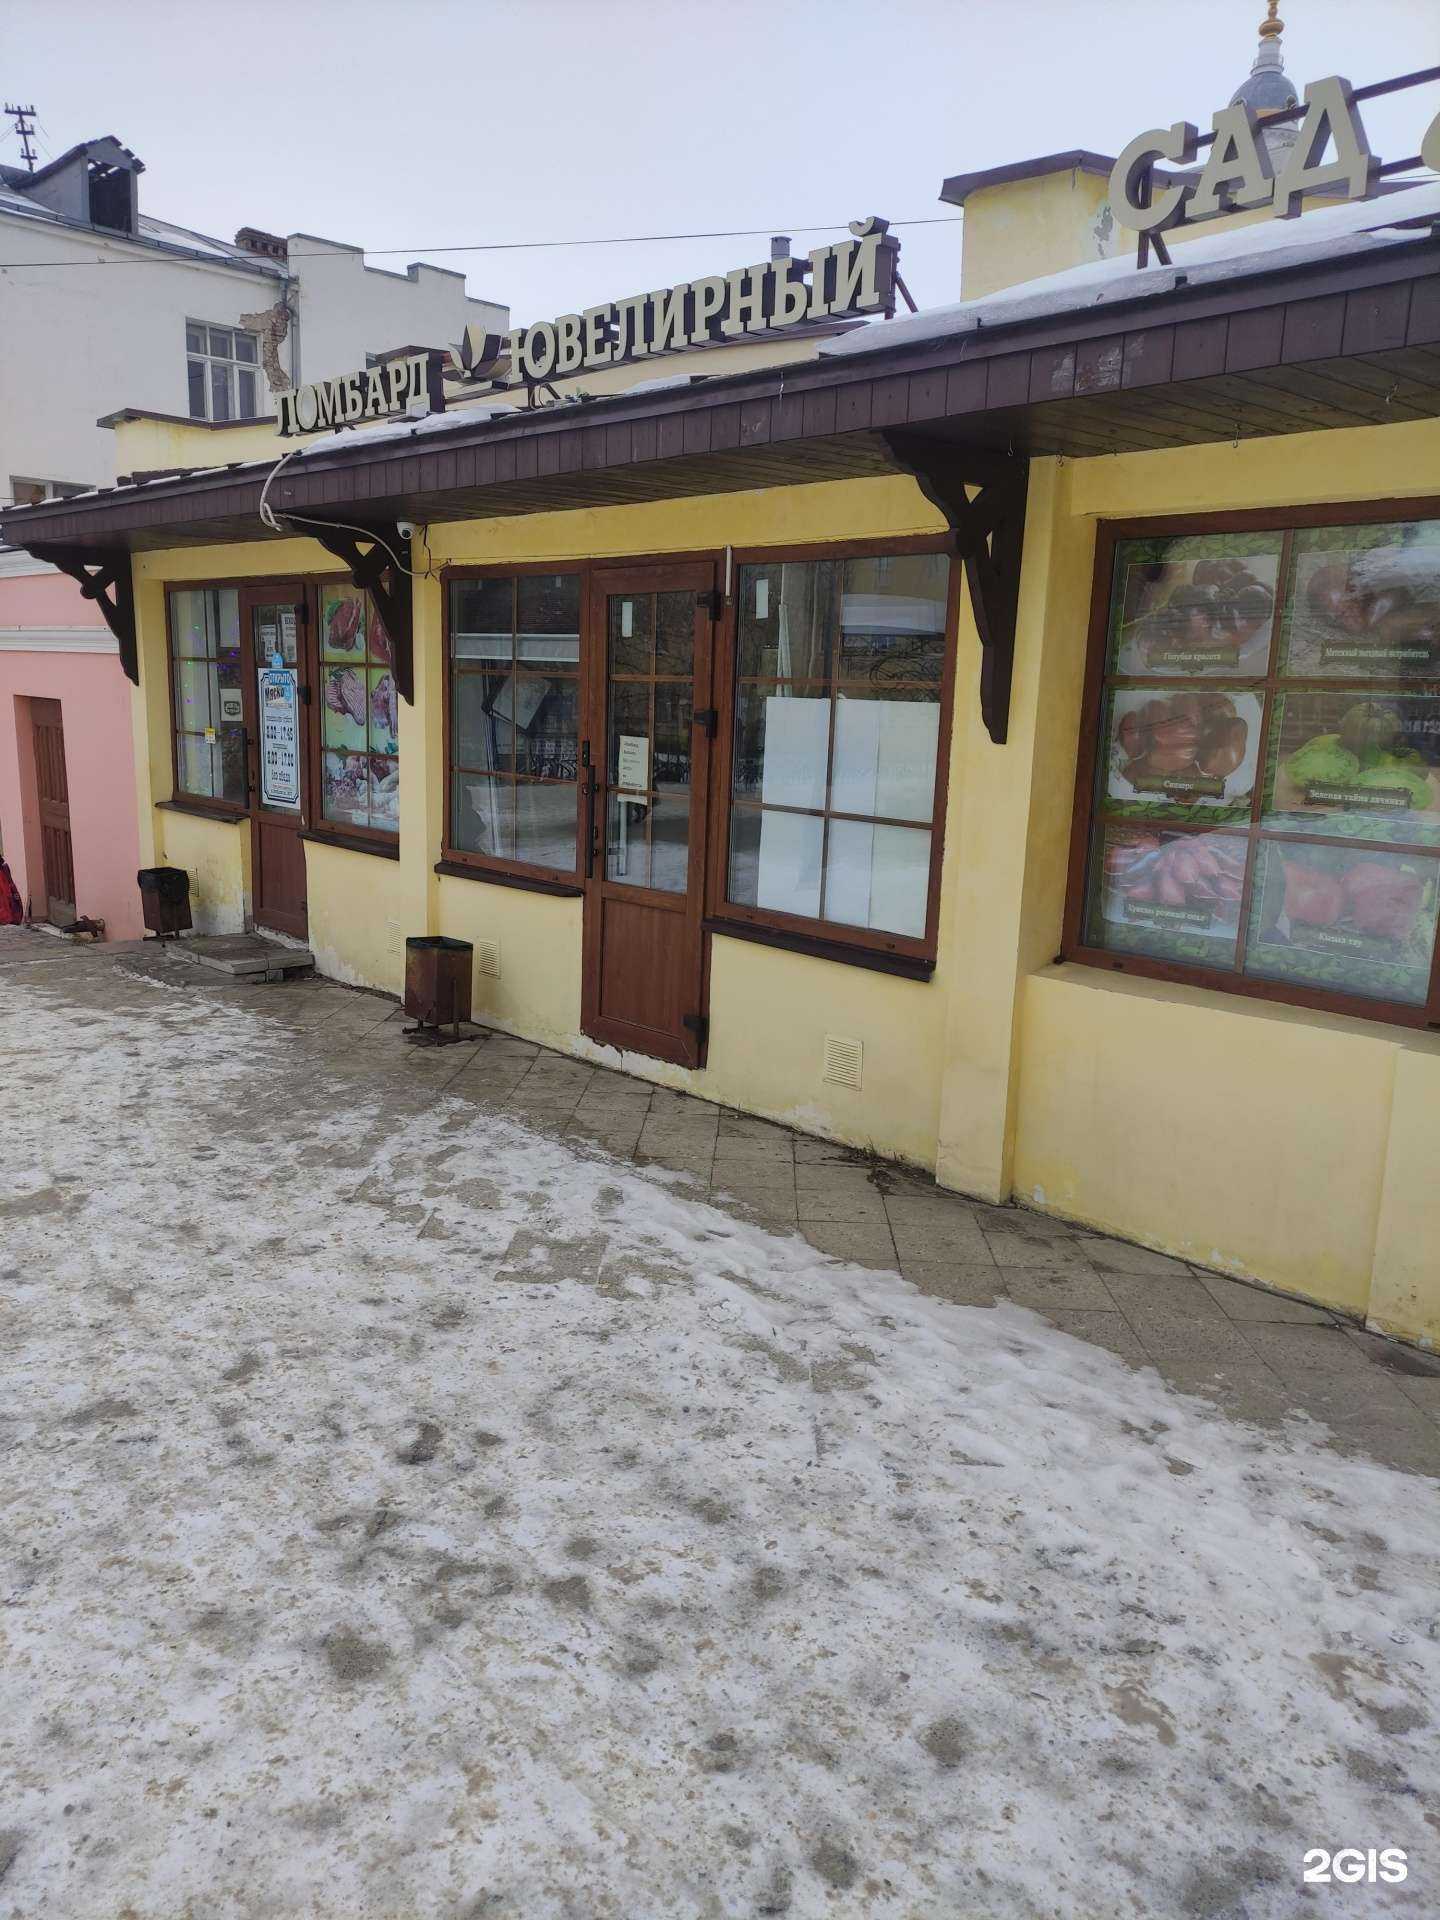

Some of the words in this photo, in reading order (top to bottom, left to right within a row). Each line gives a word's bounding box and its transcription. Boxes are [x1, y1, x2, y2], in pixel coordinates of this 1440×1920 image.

[1108, 75, 1368, 232] САД
[273, 352, 431, 436] ЛОМБАРД
[509, 216, 886, 384] ЮВЕЛИРНЫЙ
